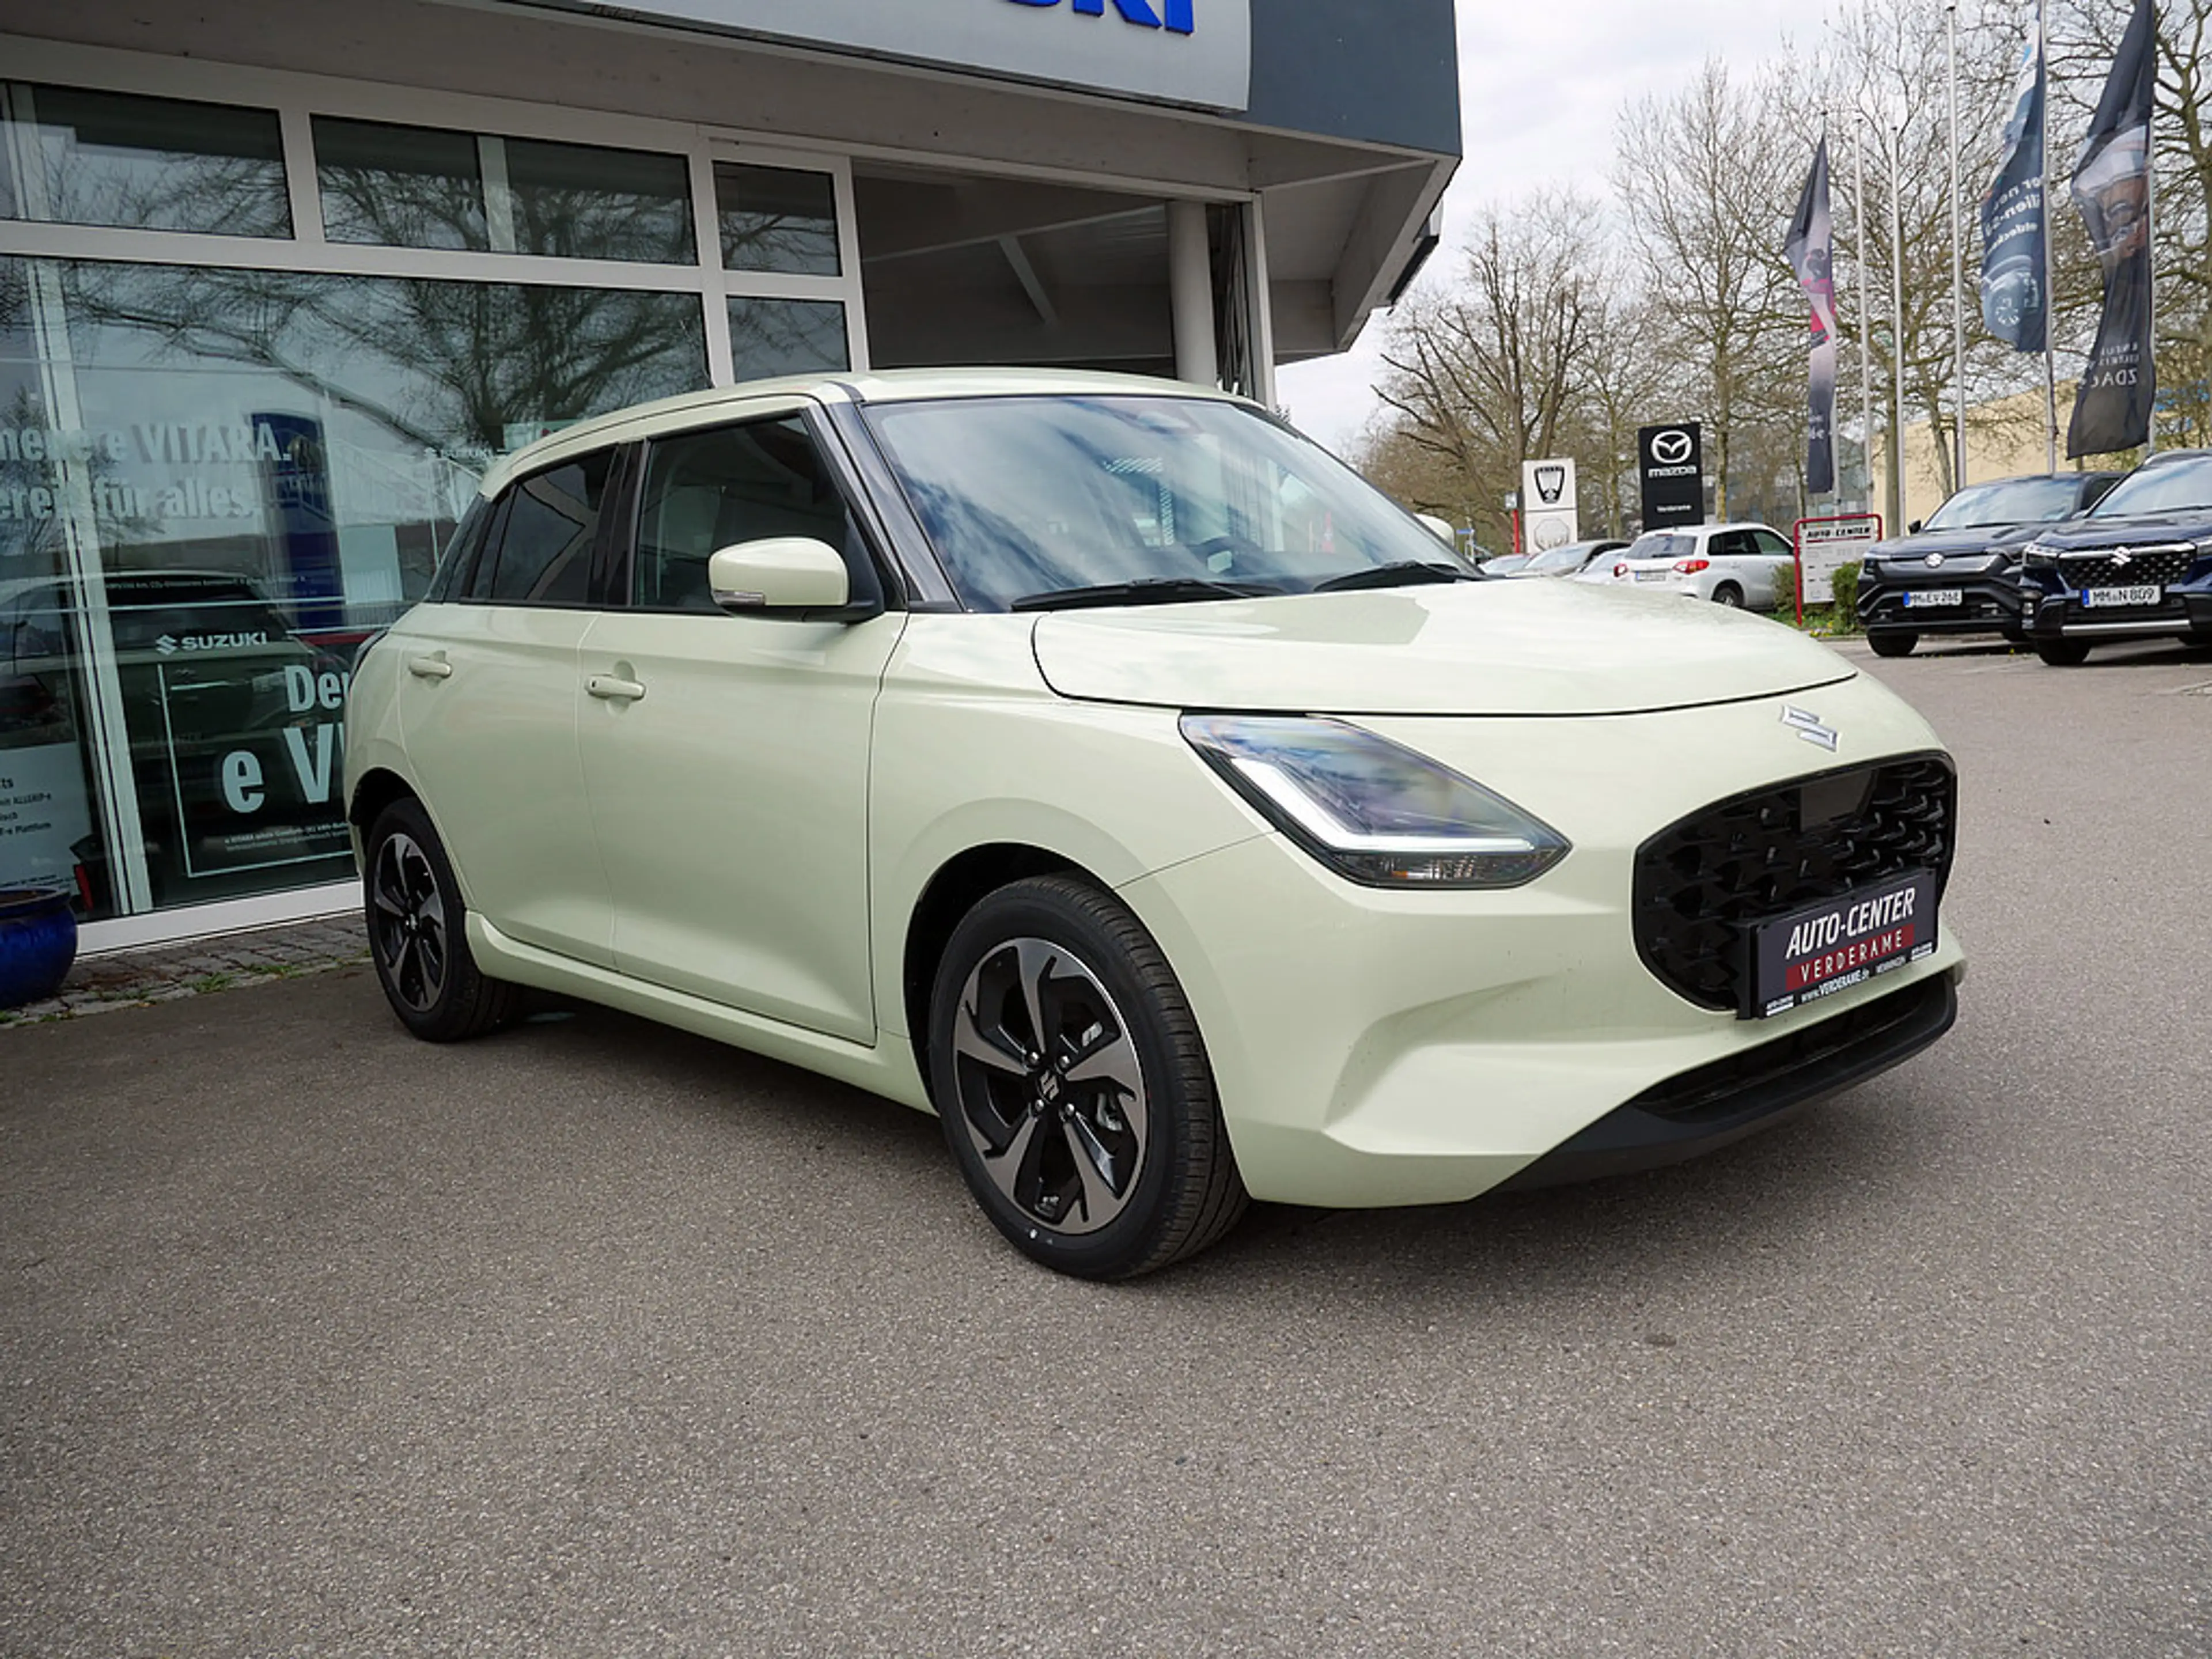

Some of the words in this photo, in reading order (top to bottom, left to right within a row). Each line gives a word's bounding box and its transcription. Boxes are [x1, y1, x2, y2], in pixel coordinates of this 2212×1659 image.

[140, 422, 291, 461] VITARA.
[1647, 465, 1697, 479] mazda
[94, 477, 150, 517] für
[164, 478, 262, 517] alles.
[2119, 589, 2127, 600] N
[180, 631, 268, 651] SUZUKI
[222, 749, 265, 813] e
[283, 723, 344, 804] V
[1786, 887, 1915, 960] AUTO-CENTER
[1801, 929, 1903, 982] VERDERAME
